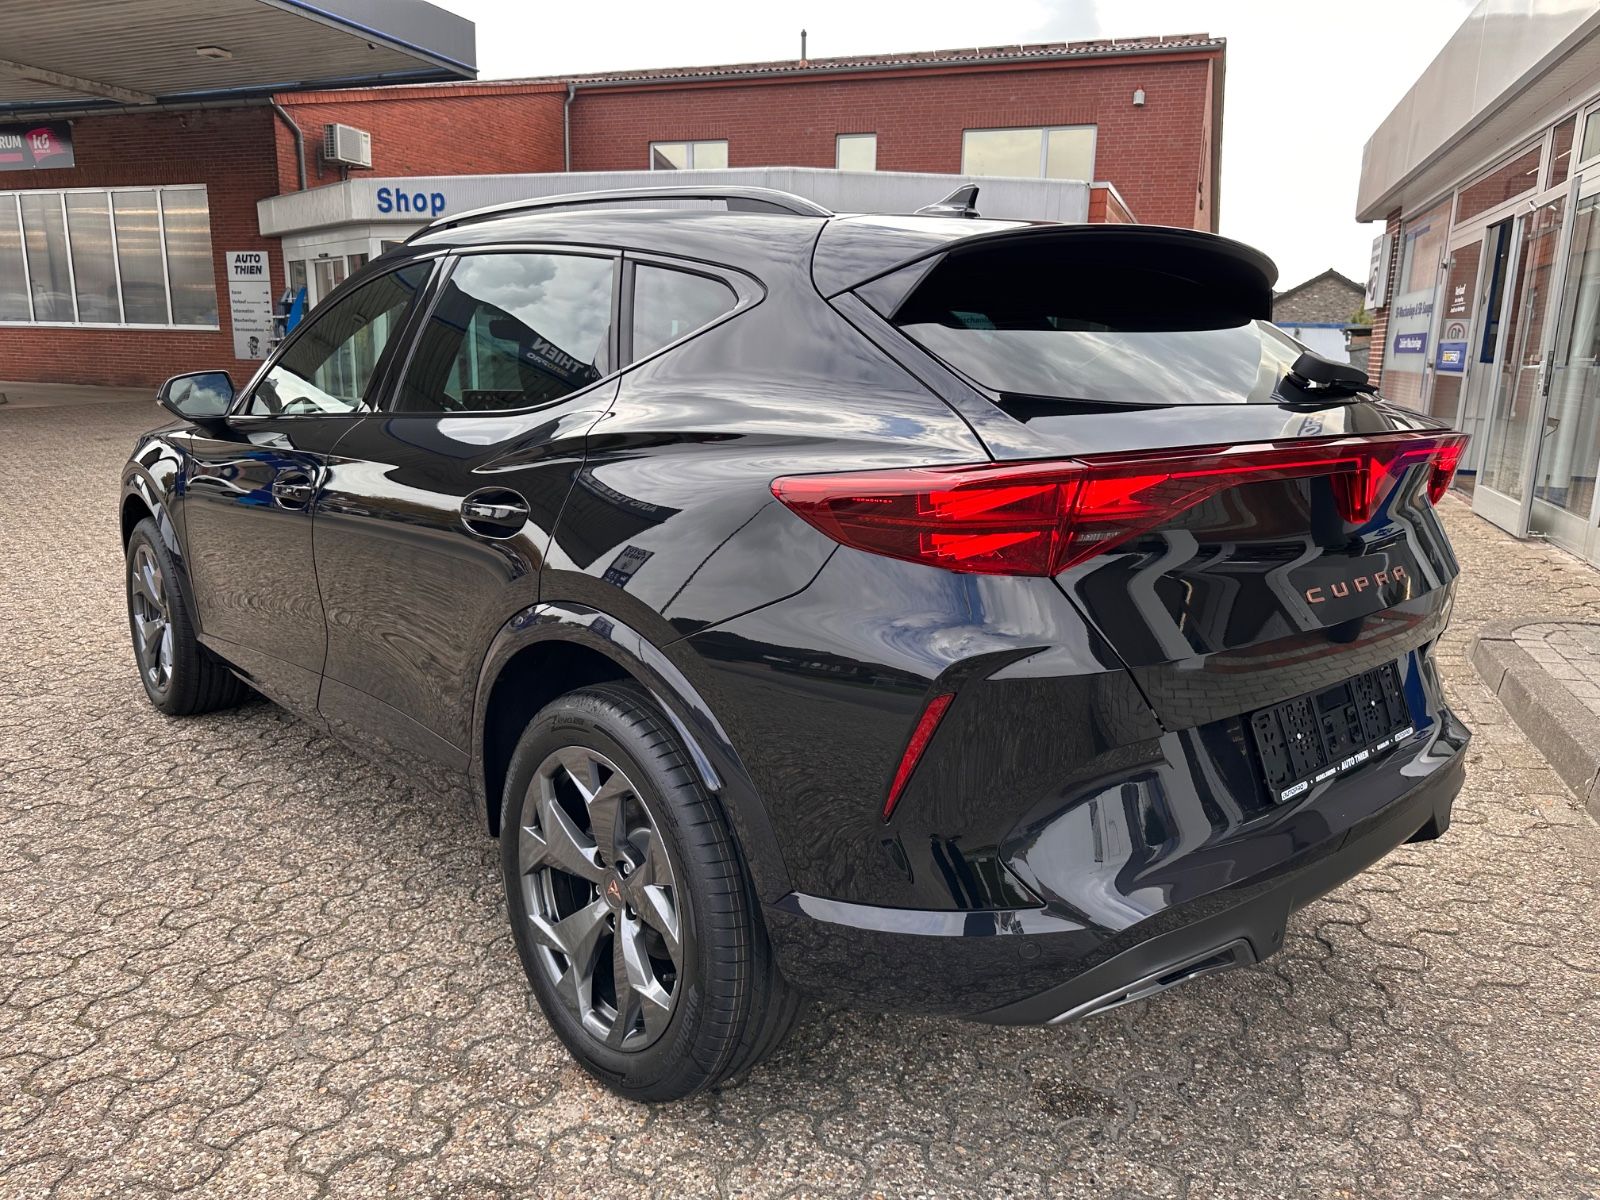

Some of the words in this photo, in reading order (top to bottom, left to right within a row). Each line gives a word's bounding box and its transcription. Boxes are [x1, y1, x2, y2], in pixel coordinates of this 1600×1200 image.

[377, 187, 446, 217] Shop
[235, 253, 261, 264] AUTO
[234, 265, 262, 275] THIEN
[1305, 565, 1406, 604] CUPRA
